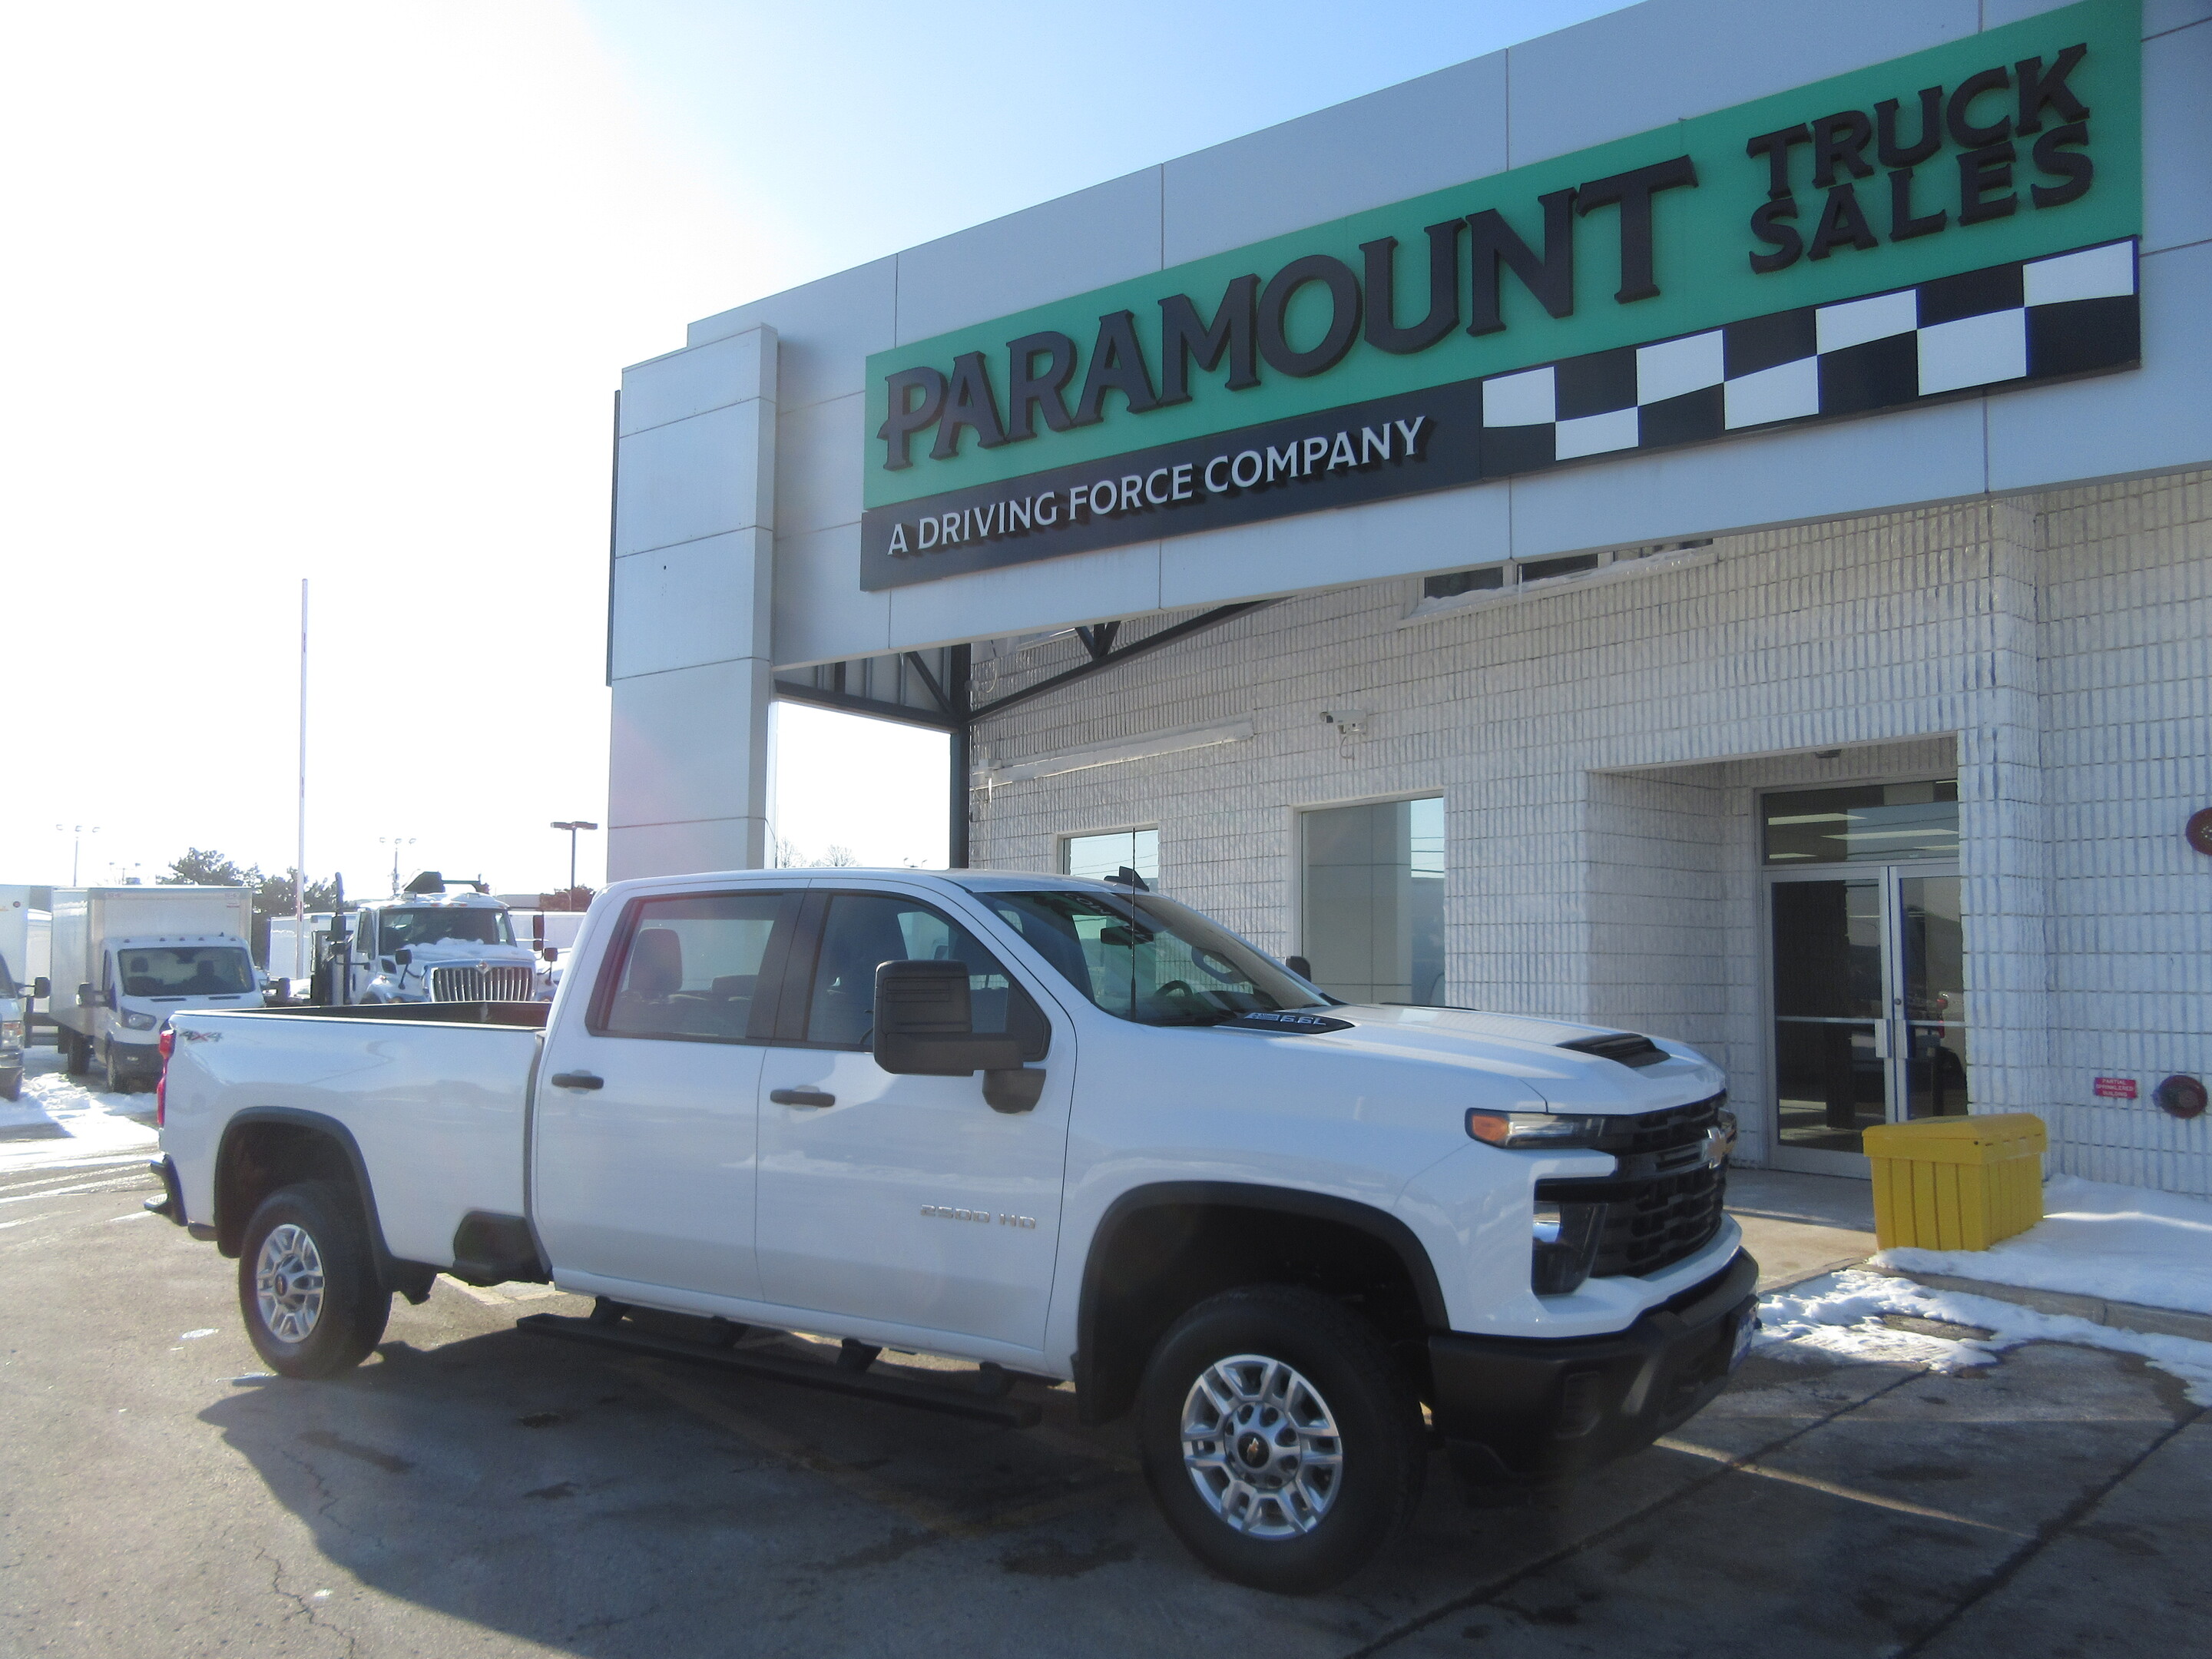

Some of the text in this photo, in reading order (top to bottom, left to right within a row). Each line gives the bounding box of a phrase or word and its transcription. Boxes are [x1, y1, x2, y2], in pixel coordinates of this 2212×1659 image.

[1745, 42, 2091, 201] TRUCK
[1748, 121, 2094, 274] SALES
[876, 154, 1700, 472] PARAMOUNT
[886, 415, 1427, 556] A DRIVING FORCE COMPANY
[1280, 1015, 1326, 1025] 6.6L
[921, 1204, 1036, 1229] 2500 HD
